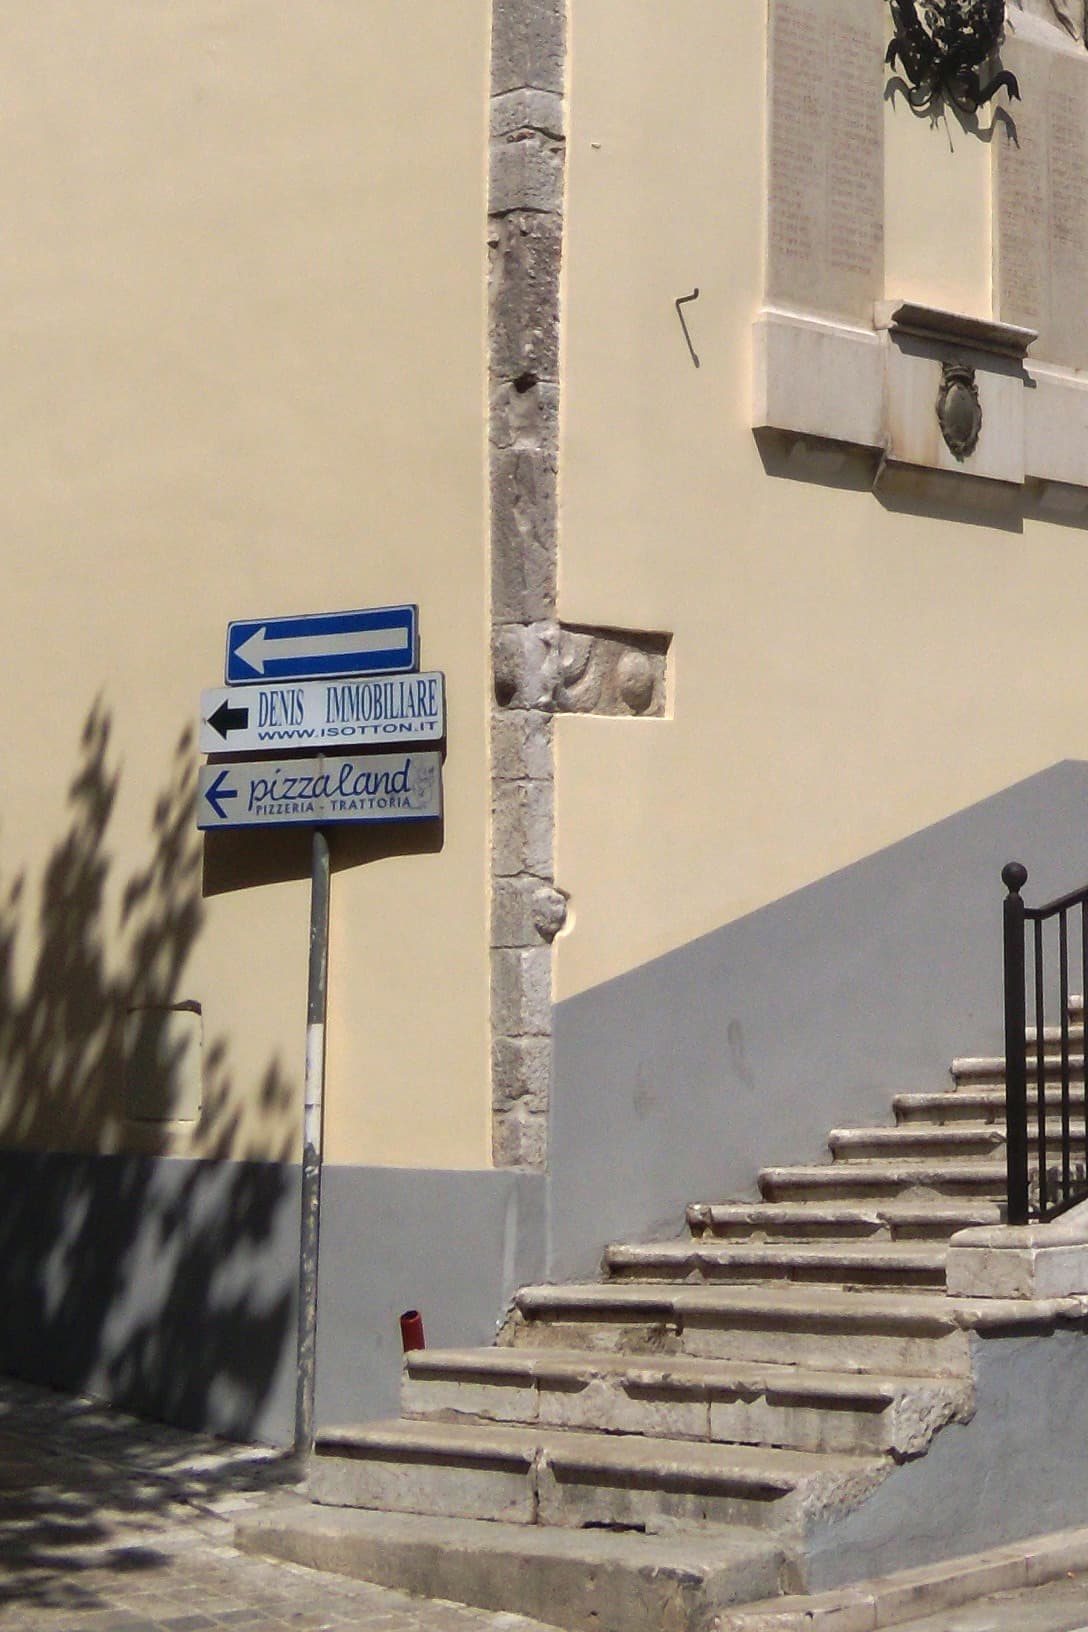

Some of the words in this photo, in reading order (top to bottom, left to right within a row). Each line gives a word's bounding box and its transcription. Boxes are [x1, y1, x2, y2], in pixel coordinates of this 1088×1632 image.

[258, 688, 304, 727] DENIS
[325, 680, 437, 723] IMMOBILIARE
[249, 758, 411, 812] pizzaland
[256, 802, 314, 815] PIZZERIA
[331, 796, 411, 811] TRATTORIA
